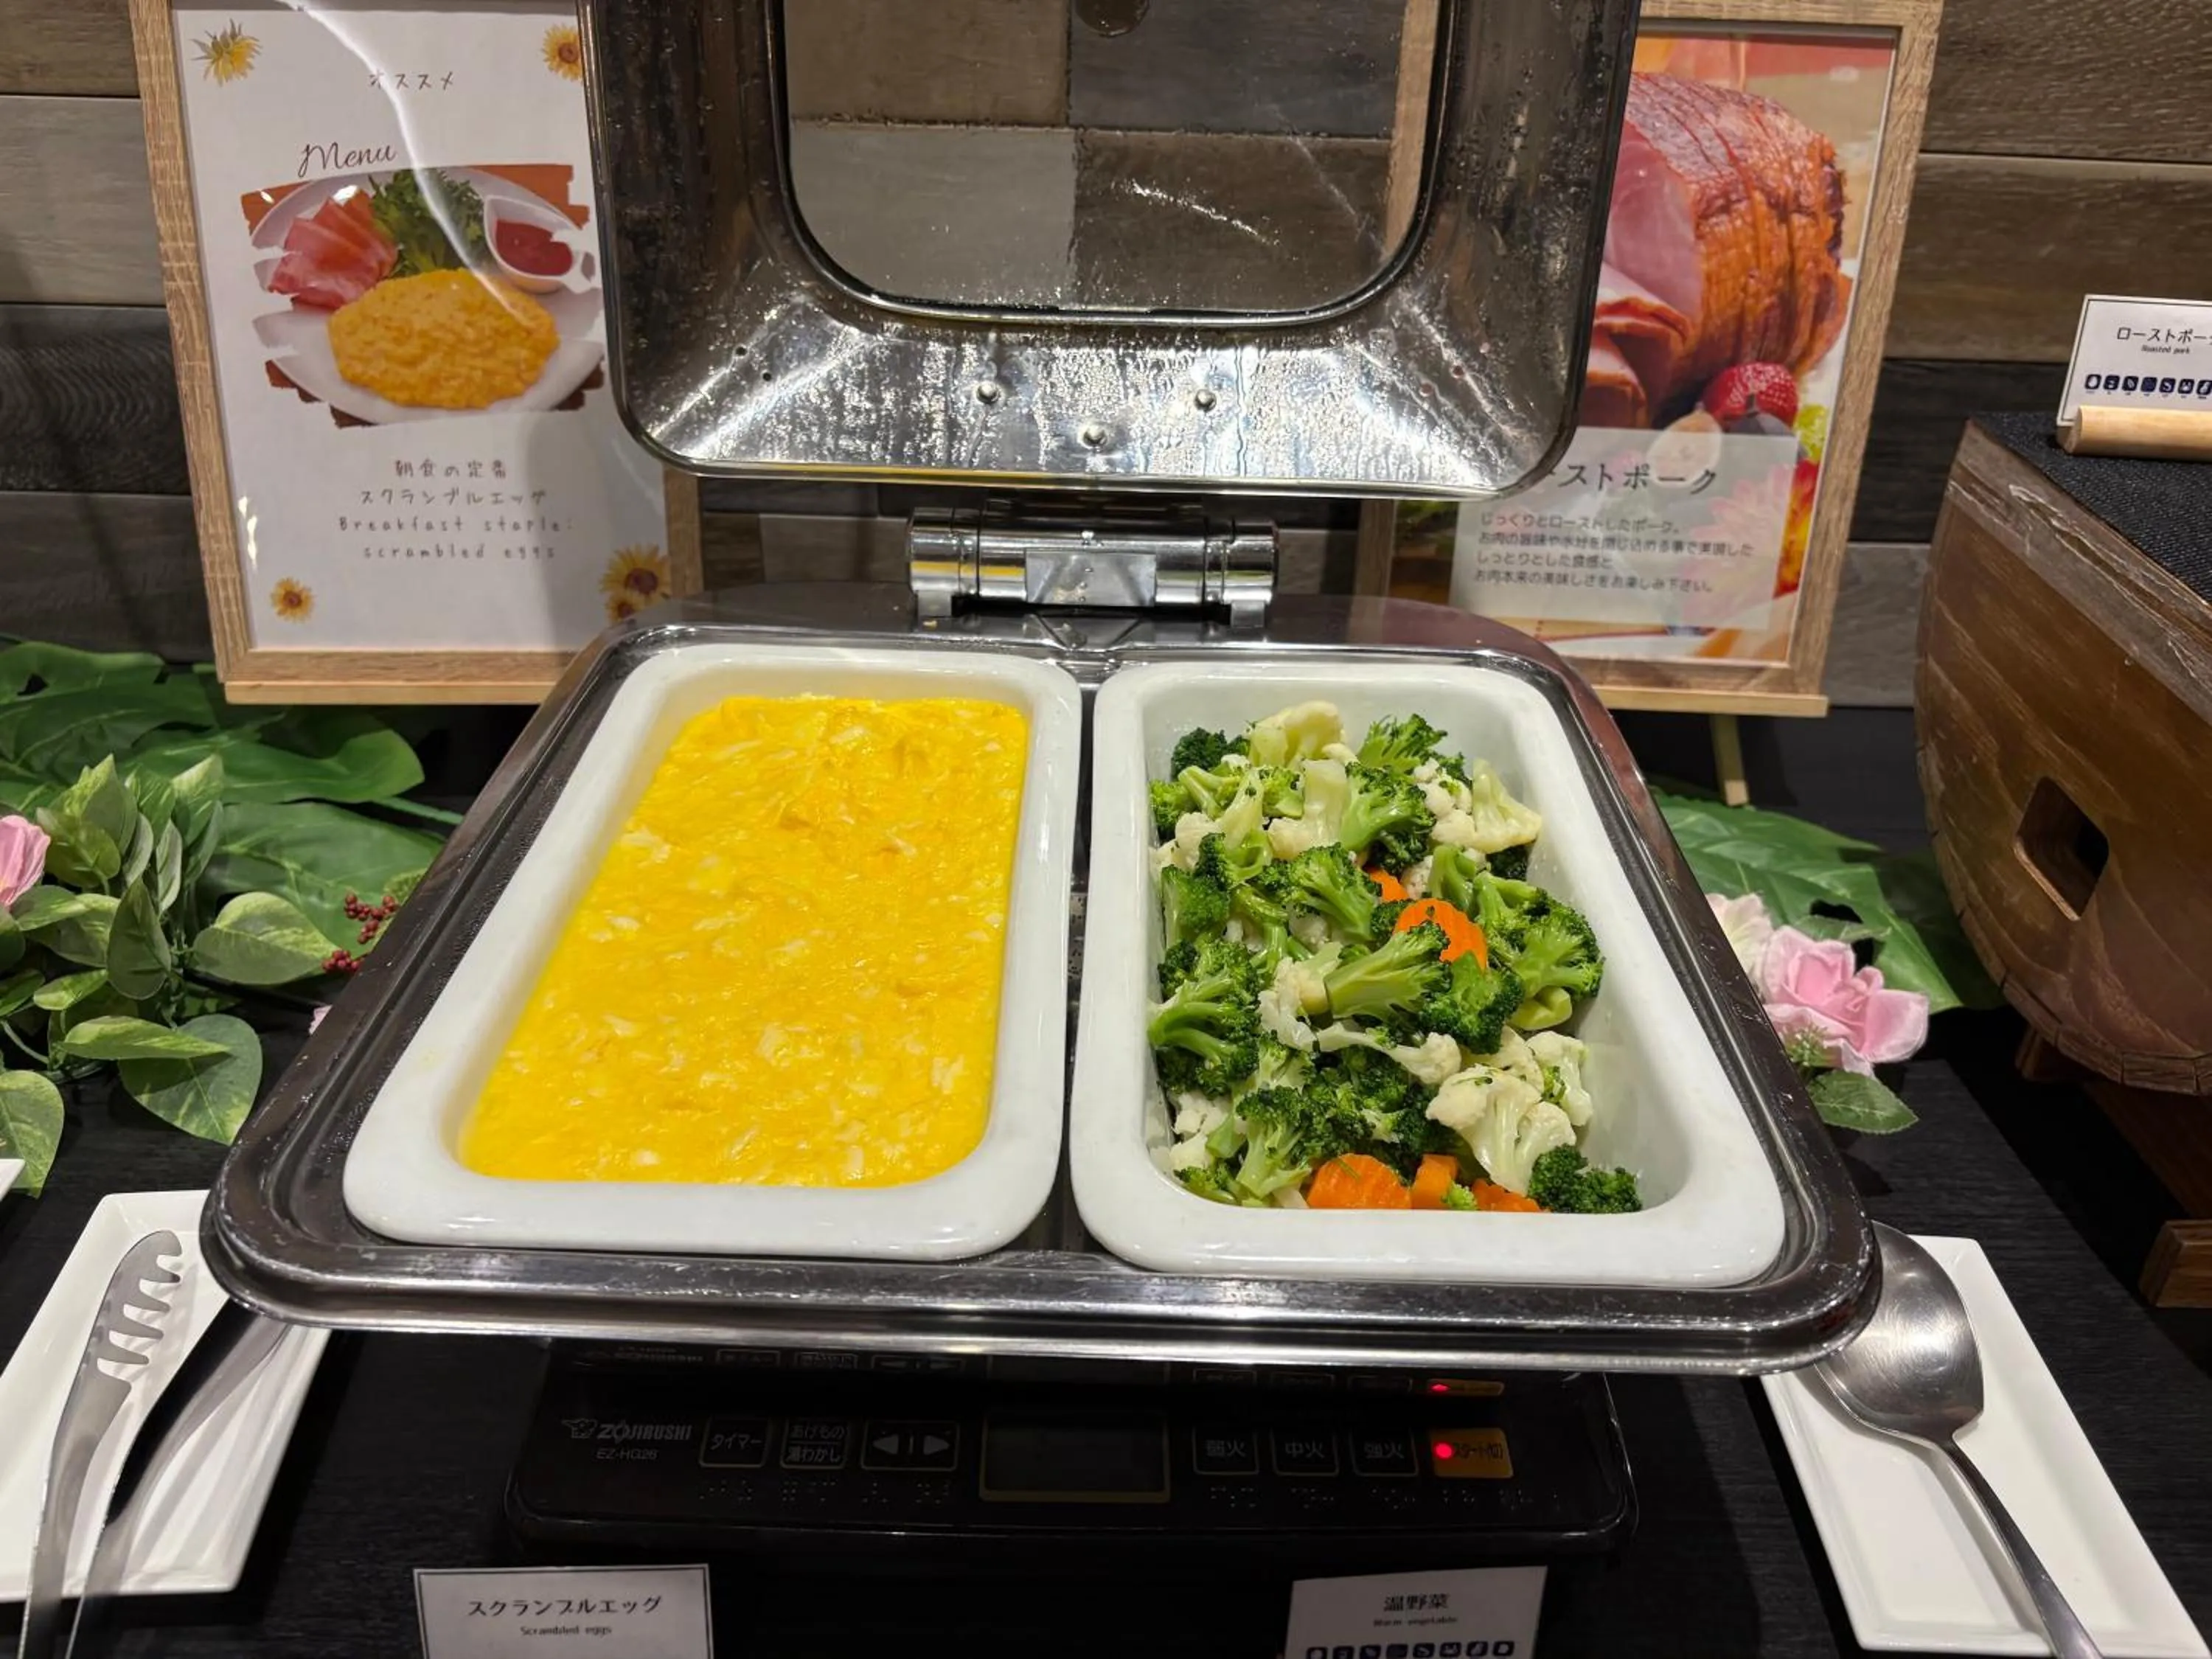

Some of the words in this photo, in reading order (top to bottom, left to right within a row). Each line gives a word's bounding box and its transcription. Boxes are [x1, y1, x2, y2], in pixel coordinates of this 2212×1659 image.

[297, 141, 397, 178] Menu
[2117, 326, 2212, 344] ローストポー
[394, 458, 507, 479] 朝食の定番
[1550, 463, 1717, 495] ストポーク
[361, 487, 547, 506] スクランブルエッグ
[339, 516, 463, 532] Breakfast
[364, 543, 485, 559] scrambled
[504, 545, 555, 561] eggs
[596, 1419, 692, 1444] ZOJIRUSHI
[710, 1433, 762, 1450] タイマー
[1284, 1438, 1325, 1458] 中火
